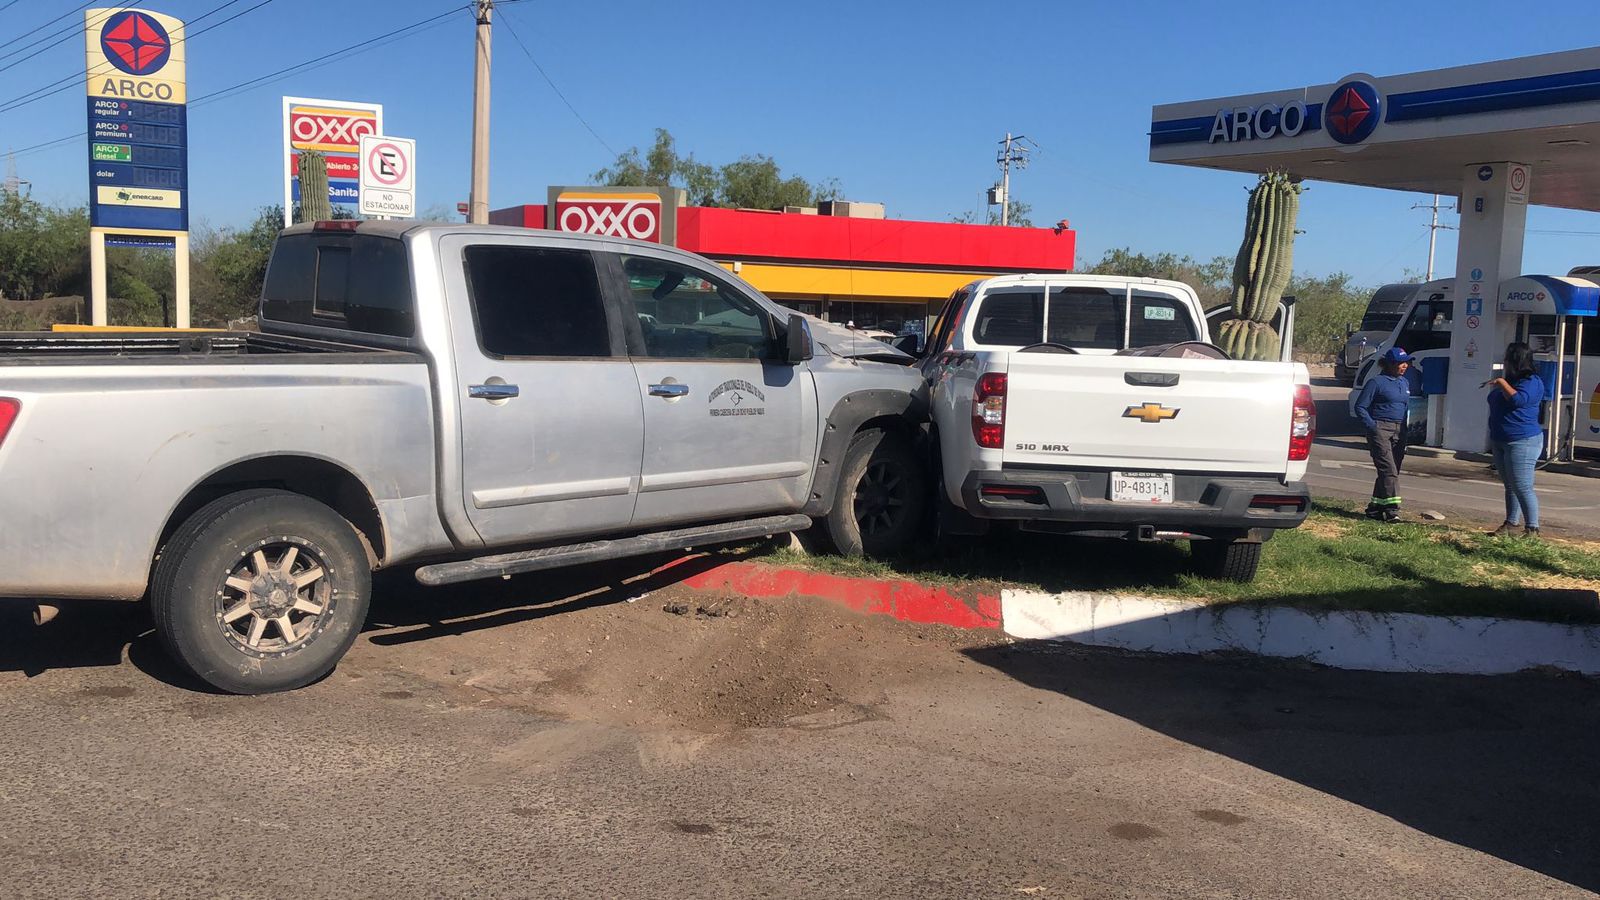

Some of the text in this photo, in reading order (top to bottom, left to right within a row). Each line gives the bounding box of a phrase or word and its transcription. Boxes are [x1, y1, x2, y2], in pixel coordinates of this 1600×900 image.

[102, 78, 173, 100] ARCO
[1208, 100, 1306, 144] ARCO
[95, 130, 127, 138] premium
[293, 116, 375, 143] OXXO
[96, 145, 119, 153] ARCO
[327, 162, 351, 171] Abierto
[96, 170, 115, 178] dolar
[365, 201, 410, 211] ESTACIONAR
[560, 204, 656, 240] OXXO
[1507, 292, 1535, 301] ARCO
[1016, 443, 1070, 452] S10 MAX
[1114, 480, 1170, 496] UP-4831-A
